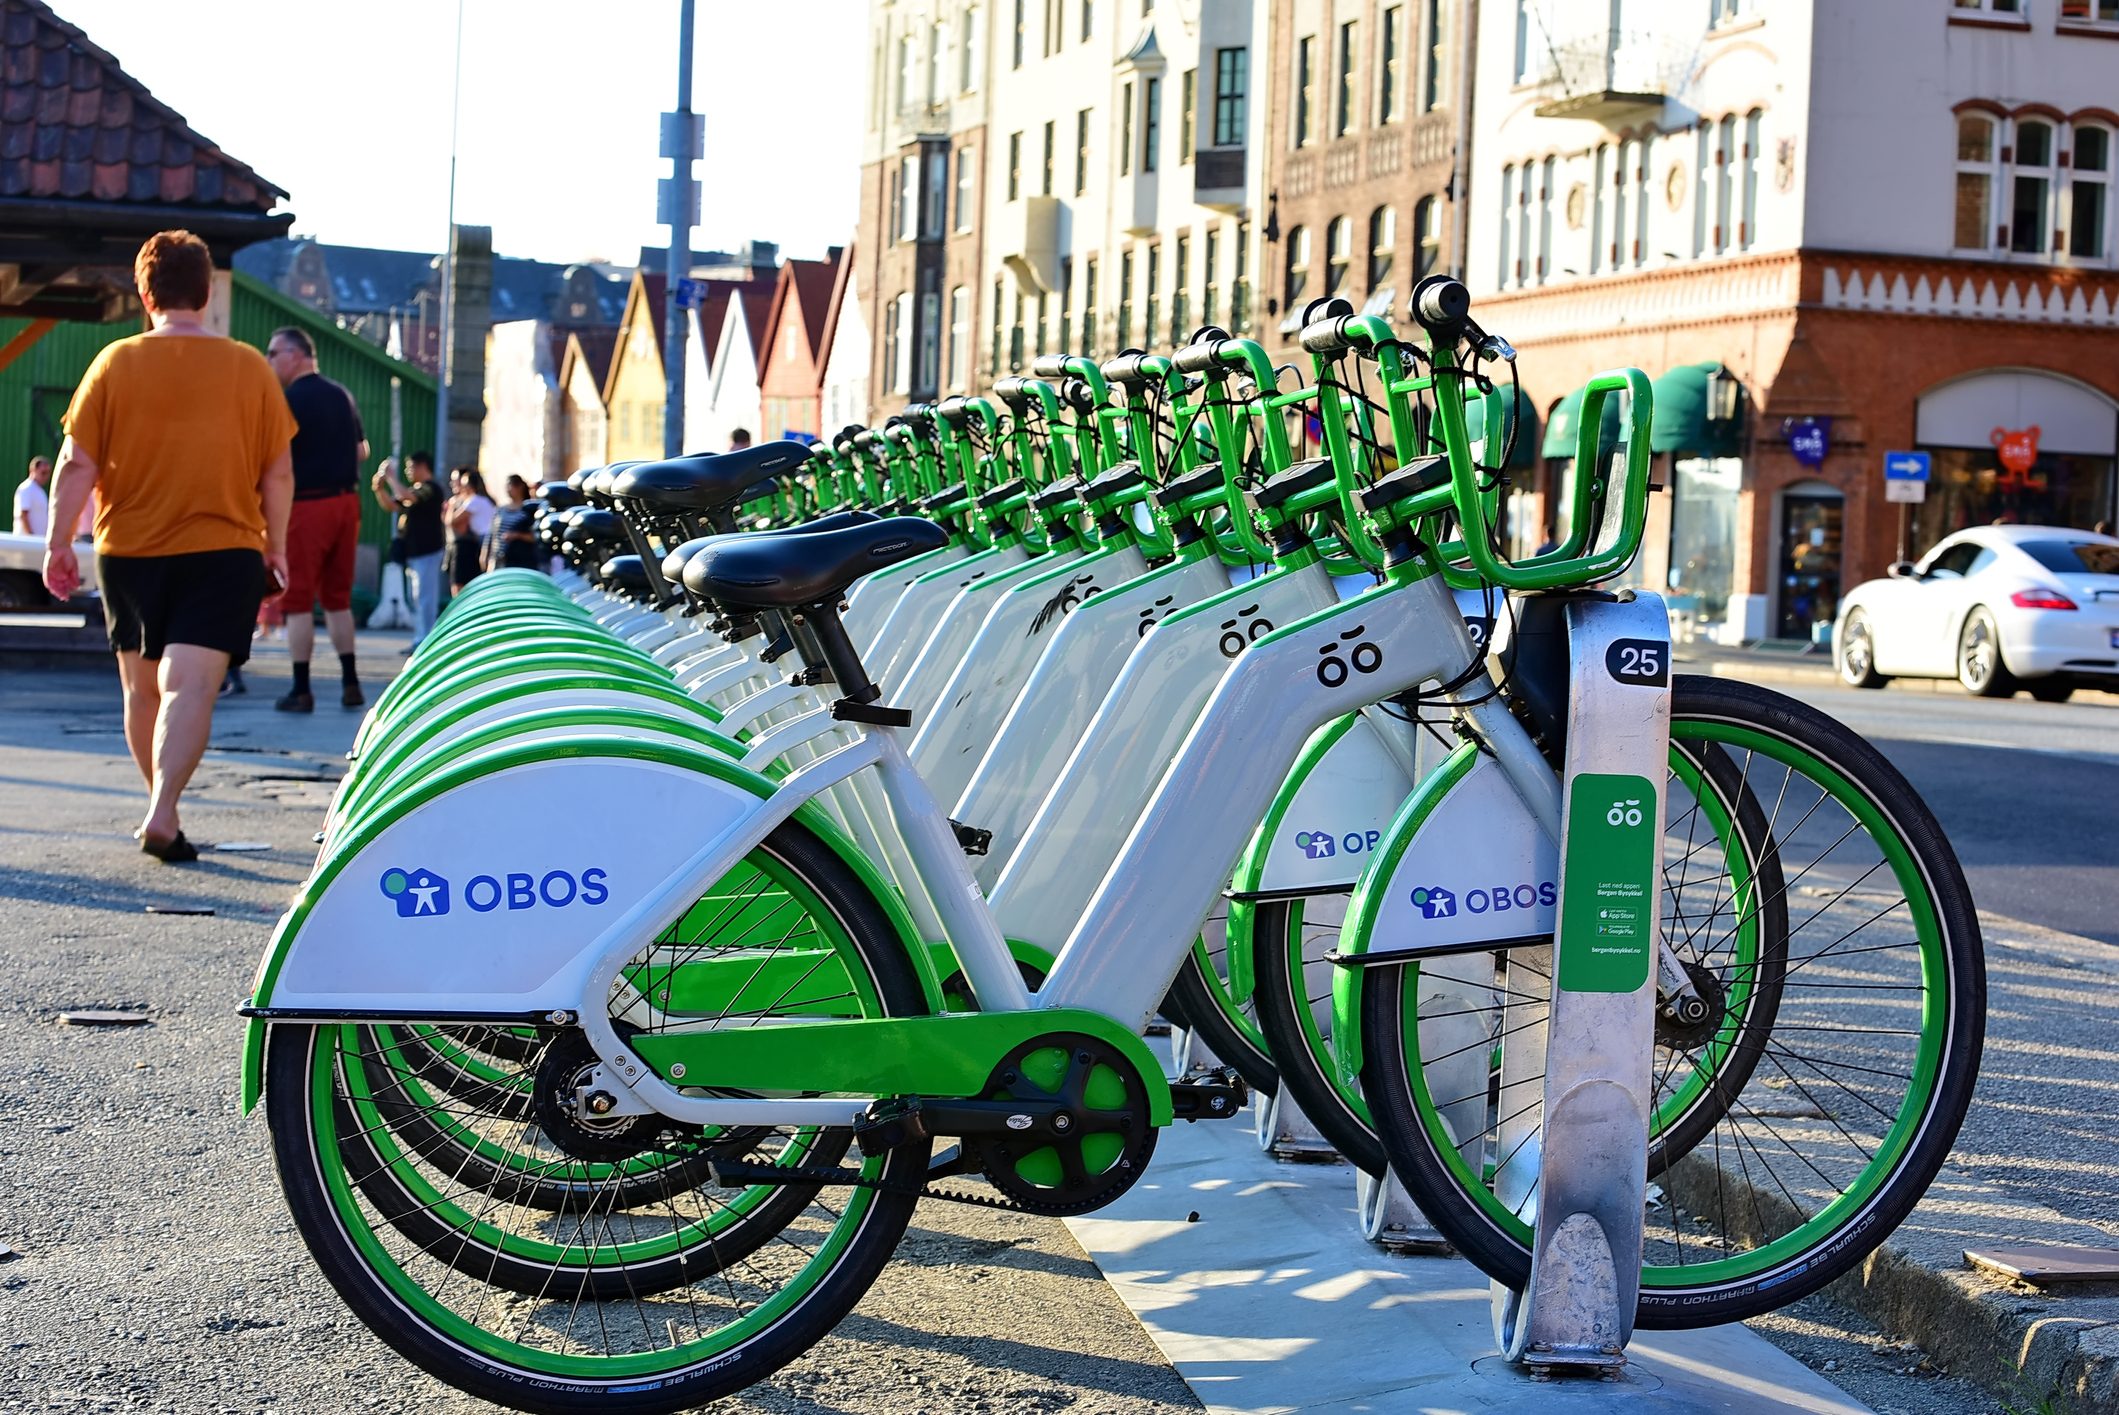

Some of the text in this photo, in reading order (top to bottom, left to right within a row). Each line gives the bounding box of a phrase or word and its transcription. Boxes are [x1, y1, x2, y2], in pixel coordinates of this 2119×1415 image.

[1620, 647, 1658, 676] 25
[464, 867, 609, 912] OBOS
[1465, 881, 1557, 914] OBOS
[1597, 889, 1643, 897] Bergen Bysykkel
[1607, 927, 1635, 936] Google Play
[1809, 1212, 1877, 1268] SCHWALBE
[1640, 1285, 1755, 1305] MARATHON PLUS
[486, 1366, 524, 1383] PLUS
[663, 1351, 742, 1387] SCHWALBE
[528, 1379, 605, 1394] MARATHON
